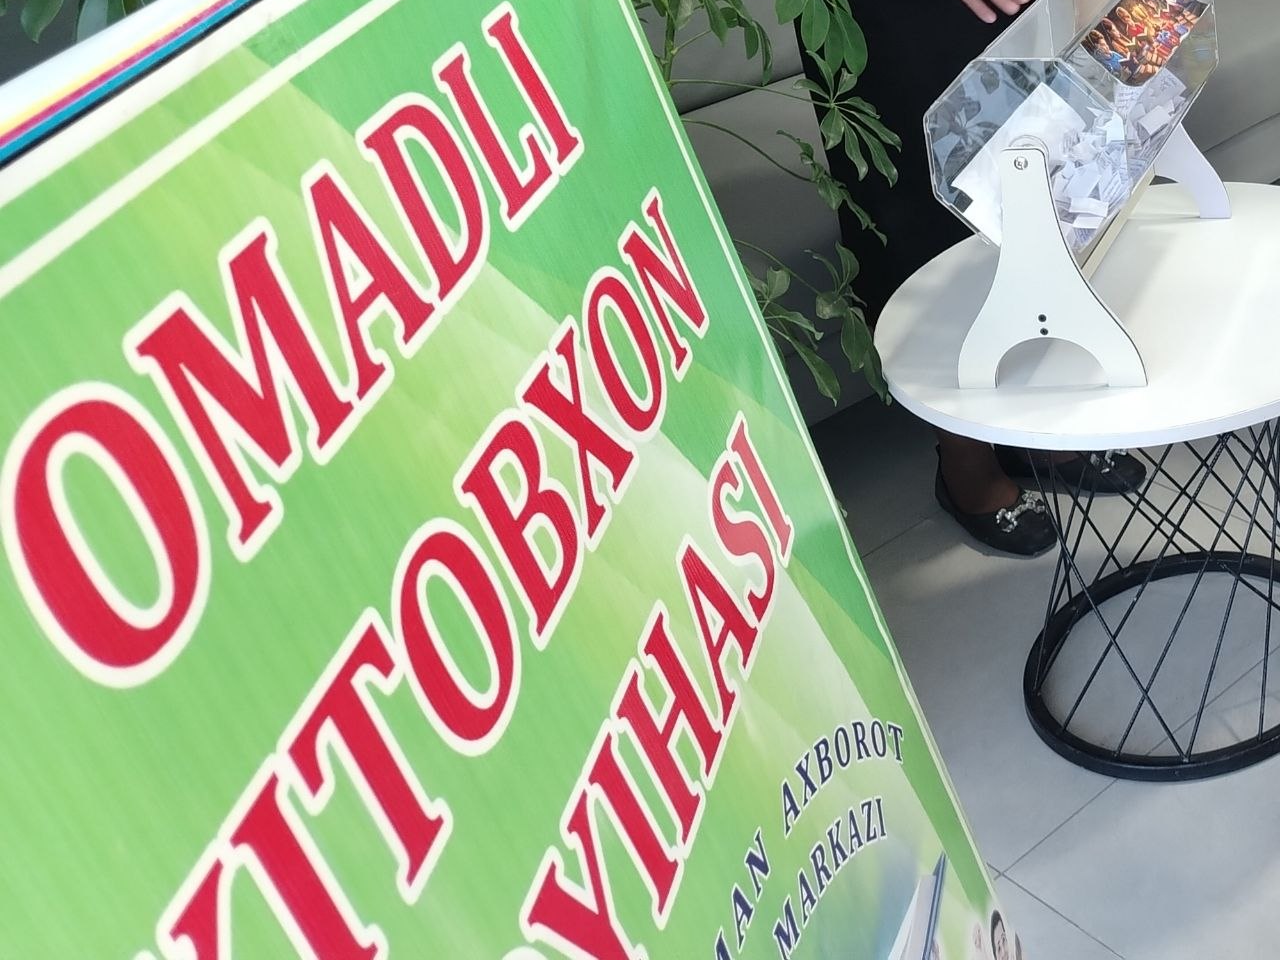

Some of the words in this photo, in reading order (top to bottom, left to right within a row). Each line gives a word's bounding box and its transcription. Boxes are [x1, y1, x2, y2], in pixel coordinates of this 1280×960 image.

[8, 5, 581, 678] OMADLI
[520, 420, 792, 960] YIHASI
[781, 719, 904, 835] AXBOROT
[772, 796, 888, 960] MARKAZI
